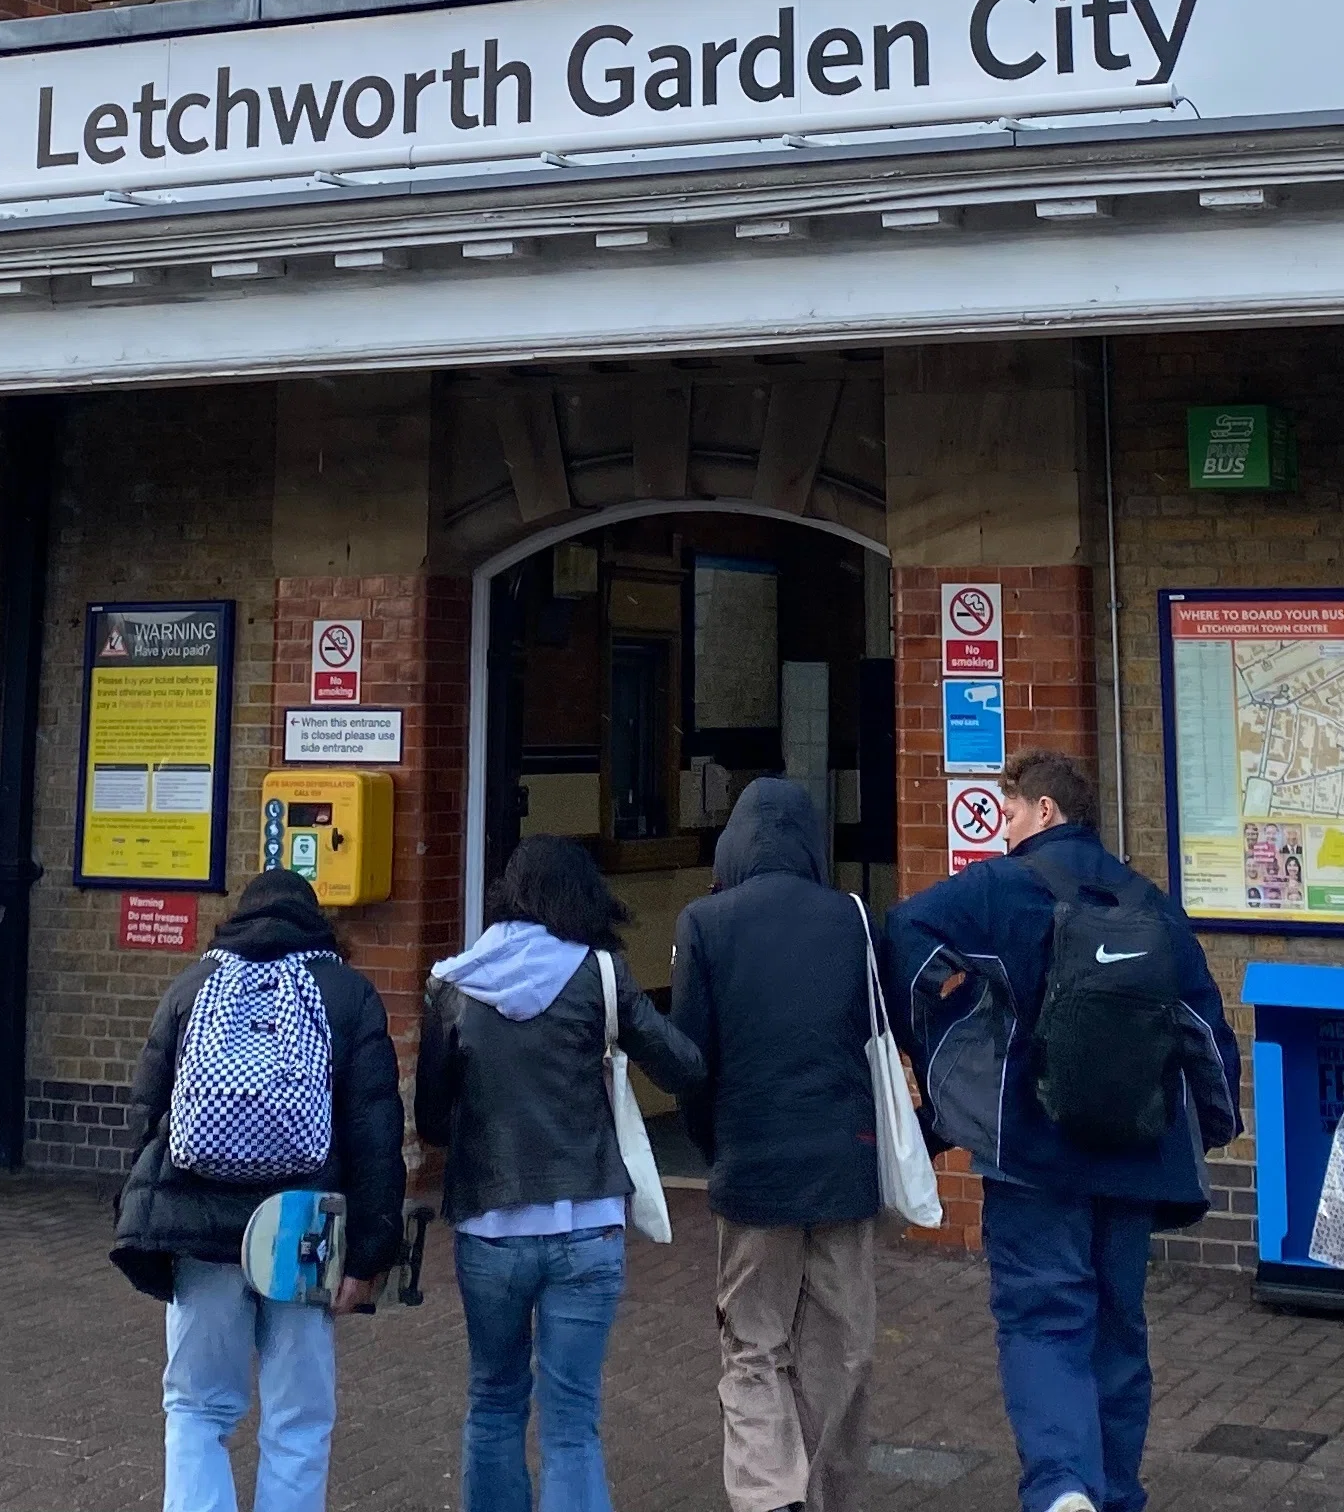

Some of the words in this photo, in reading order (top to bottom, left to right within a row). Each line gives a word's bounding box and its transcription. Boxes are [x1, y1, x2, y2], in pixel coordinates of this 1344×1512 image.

[36, 38, 532, 169] Letchworth
[567, 6, 930, 117] Garden
[1203, 457, 1246, 473] BUS
[1179, 610, 1219, 621] WHERE
[1222, 610, 1239, 620] TO
[1242, 610, 1282, 621] BOARD
[1285, 609, 1319, 620] YOUR
[1322, 609, 1344, 620] BUS
[134, 622, 216, 641] WARNING
[1197, 625, 1259, 633] LETCHWORTH
[1261, 625, 1291, 633] TOWN
[1293, 625, 1328, 633] CENTRE
[134, 645, 157, 657] Have
[161, 647, 181, 659] you
[183, 645, 210, 658] paid?
[965, 645, 980, 655] No
[951, 657, 994, 669] smoking
[330, 676, 342, 685] No
[318, 687, 353, 698] smoking
[301, 717, 328, 728] When
[330, 718, 347, 727] this
[350, 718, 391, 728] entrance
[301, 730, 309, 740] is
[311, 731, 342, 740] closed
[344, 731, 375, 742] please
[300, 743, 320, 753] side
[322, 744, 364, 753] entrance
[953, 856, 967, 866] No
[129, 896, 164, 910] Warning
[128, 911, 139, 921] Do
[141, 912, 154, 921] not
[155, 912, 188, 924] trespass
[139, 923, 152, 931] the
[126, 933, 156, 945] Penalty
